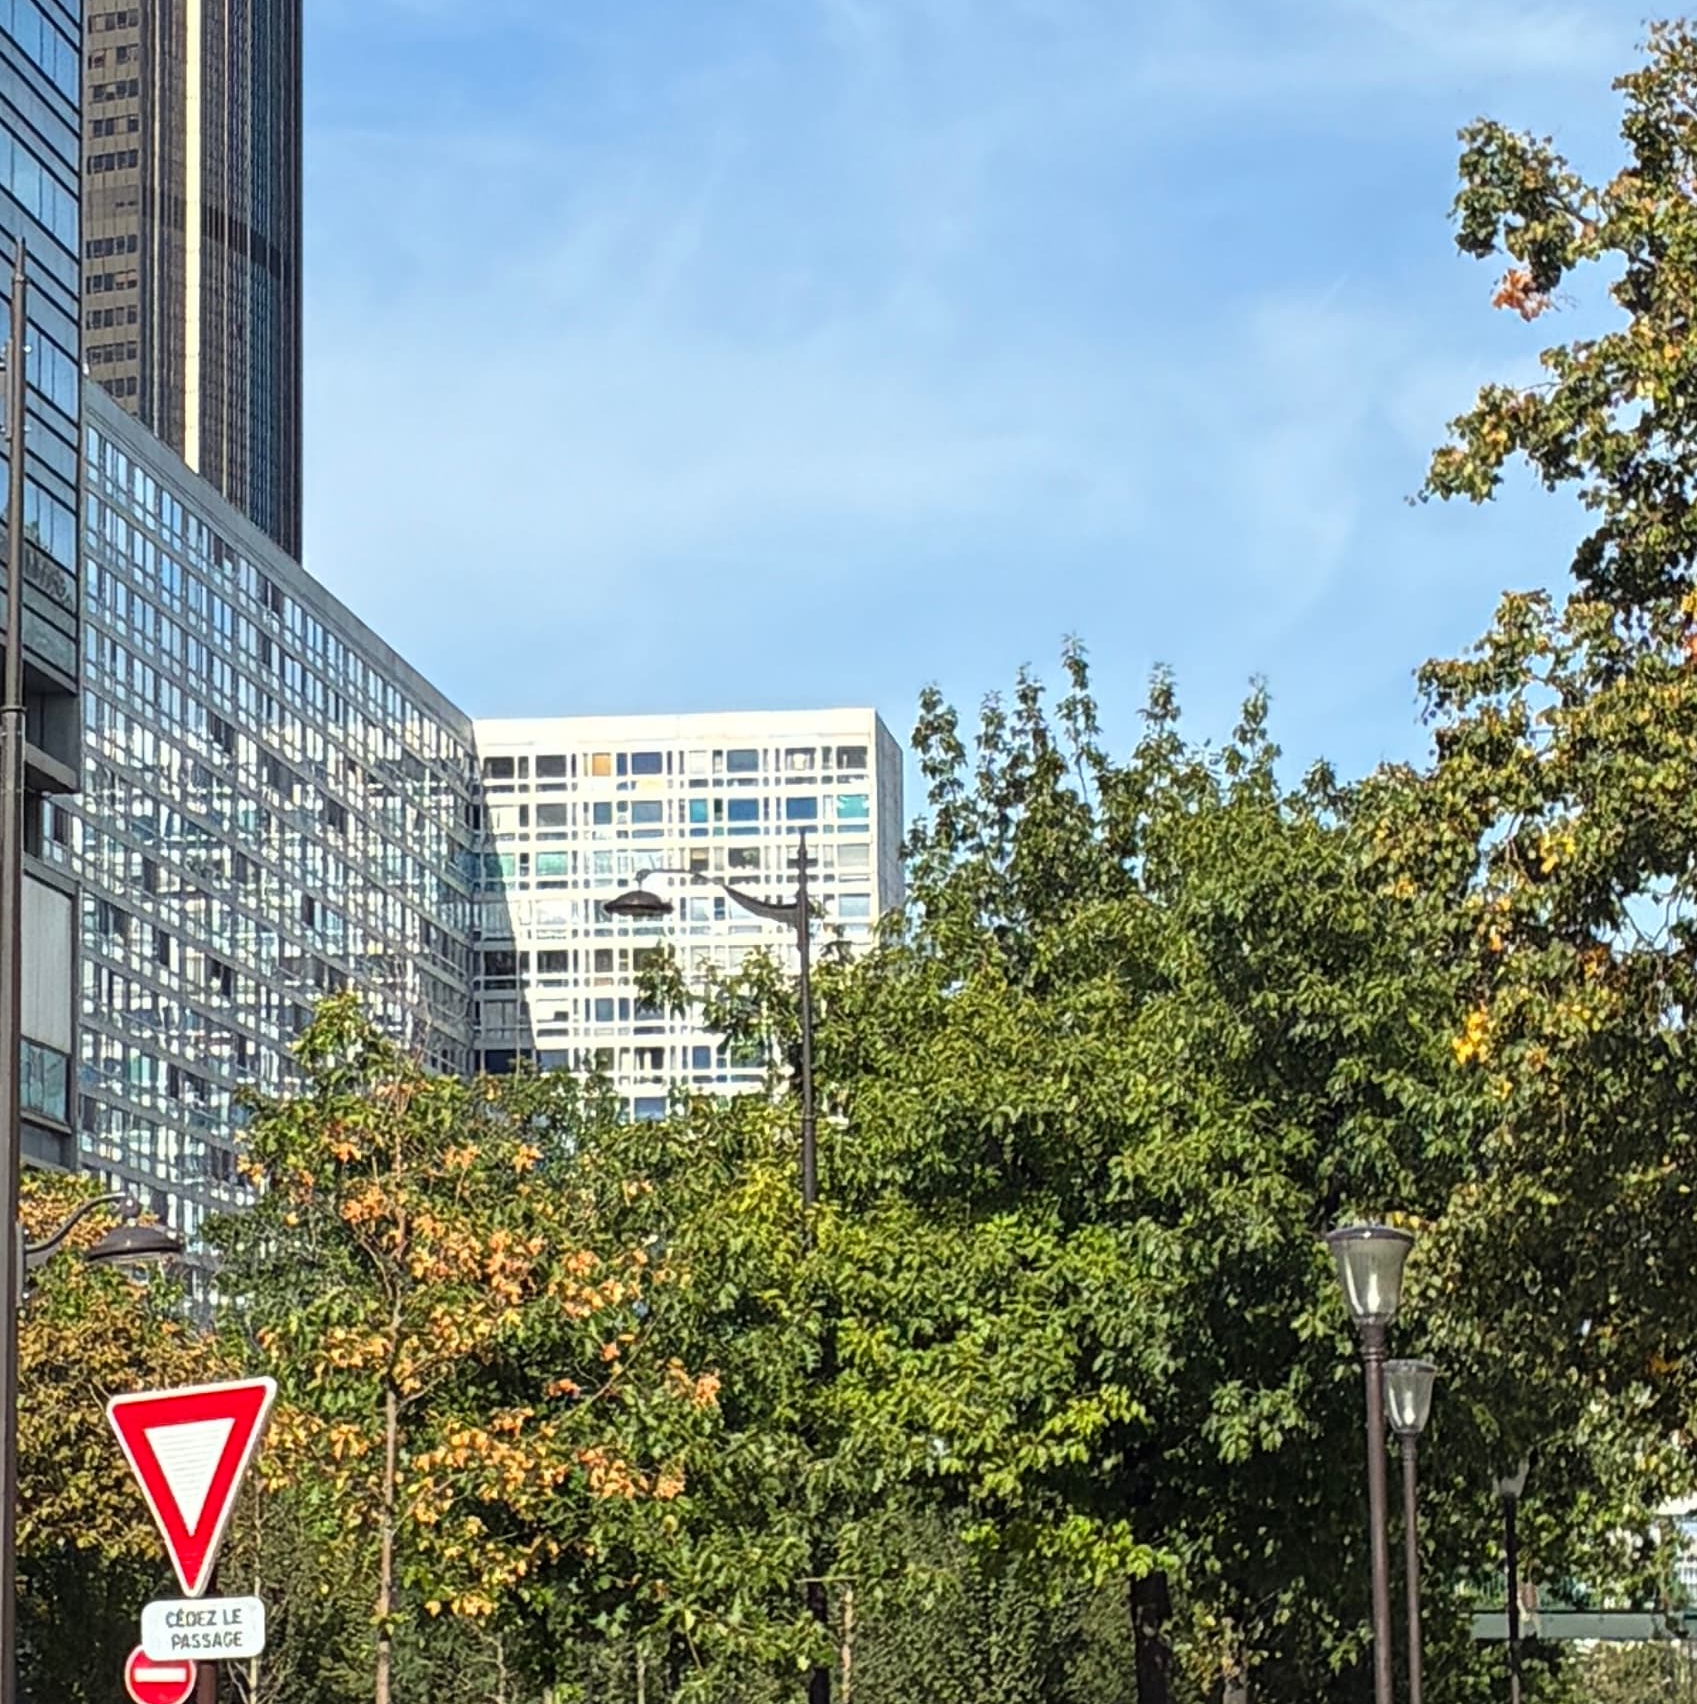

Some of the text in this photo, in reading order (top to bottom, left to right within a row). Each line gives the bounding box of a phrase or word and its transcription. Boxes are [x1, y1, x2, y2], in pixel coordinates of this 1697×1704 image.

[166, 1608, 243, 1628] CÉDEZ LE
[171, 1631, 243, 1650] PASSAGE
